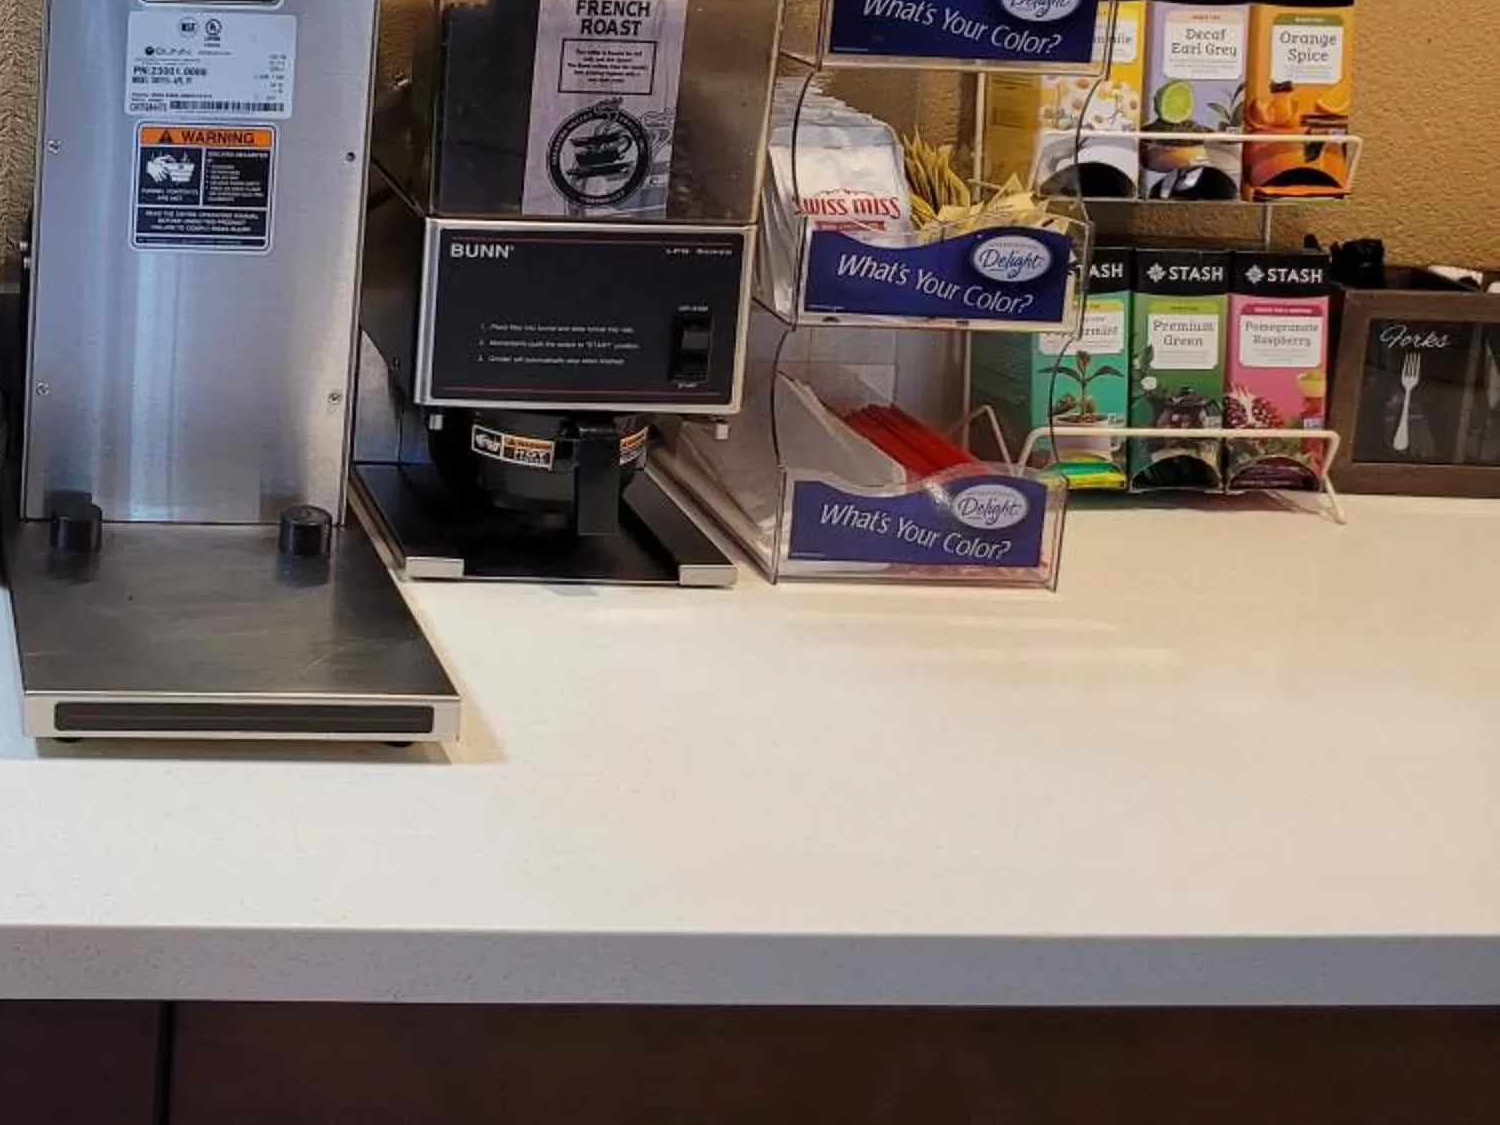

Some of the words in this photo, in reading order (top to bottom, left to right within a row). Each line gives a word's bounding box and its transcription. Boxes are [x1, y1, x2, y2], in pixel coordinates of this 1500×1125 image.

[580, 19, 643, 36] ROAST
[940, 8, 988, 41] Your
[990, 25, 1063, 54] Color?
[1185, 27, 1228, 41] Decaf
[1279, 30, 1337, 48] Orange
[1171, 42, 1203, 55] Earl
[1205, 42, 1238, 57] Grey
[1287, 47, 1329, 64] Spice
[181, 129, 256, 145] WARNING
[450, 242, 510, 260] BUNN
[978, 248, 1043, 280] Delight
[1169, 265, 1224, 282] STASH
[1267, 268, 1323, 284] STASH
[836, 253, 908, 287] What's
[915, 270, 962, 301] Your
[963, 285, 1035, 315] Color?
[1152, 318, 1215, 333] Premium
[1244, 321, 1319, 334] Pomegranate
[1162, 334, 1204, 347] Green
[1252, 335, 1312, 349] Raspberry
[1379, 323, 1453, 350] Forks
[956, 496, 1023, 525] Delight
[820, 501, 891, 534] What's
[896, 516, 940, 548] Your
[942, 531, 1012, 560] Color?
